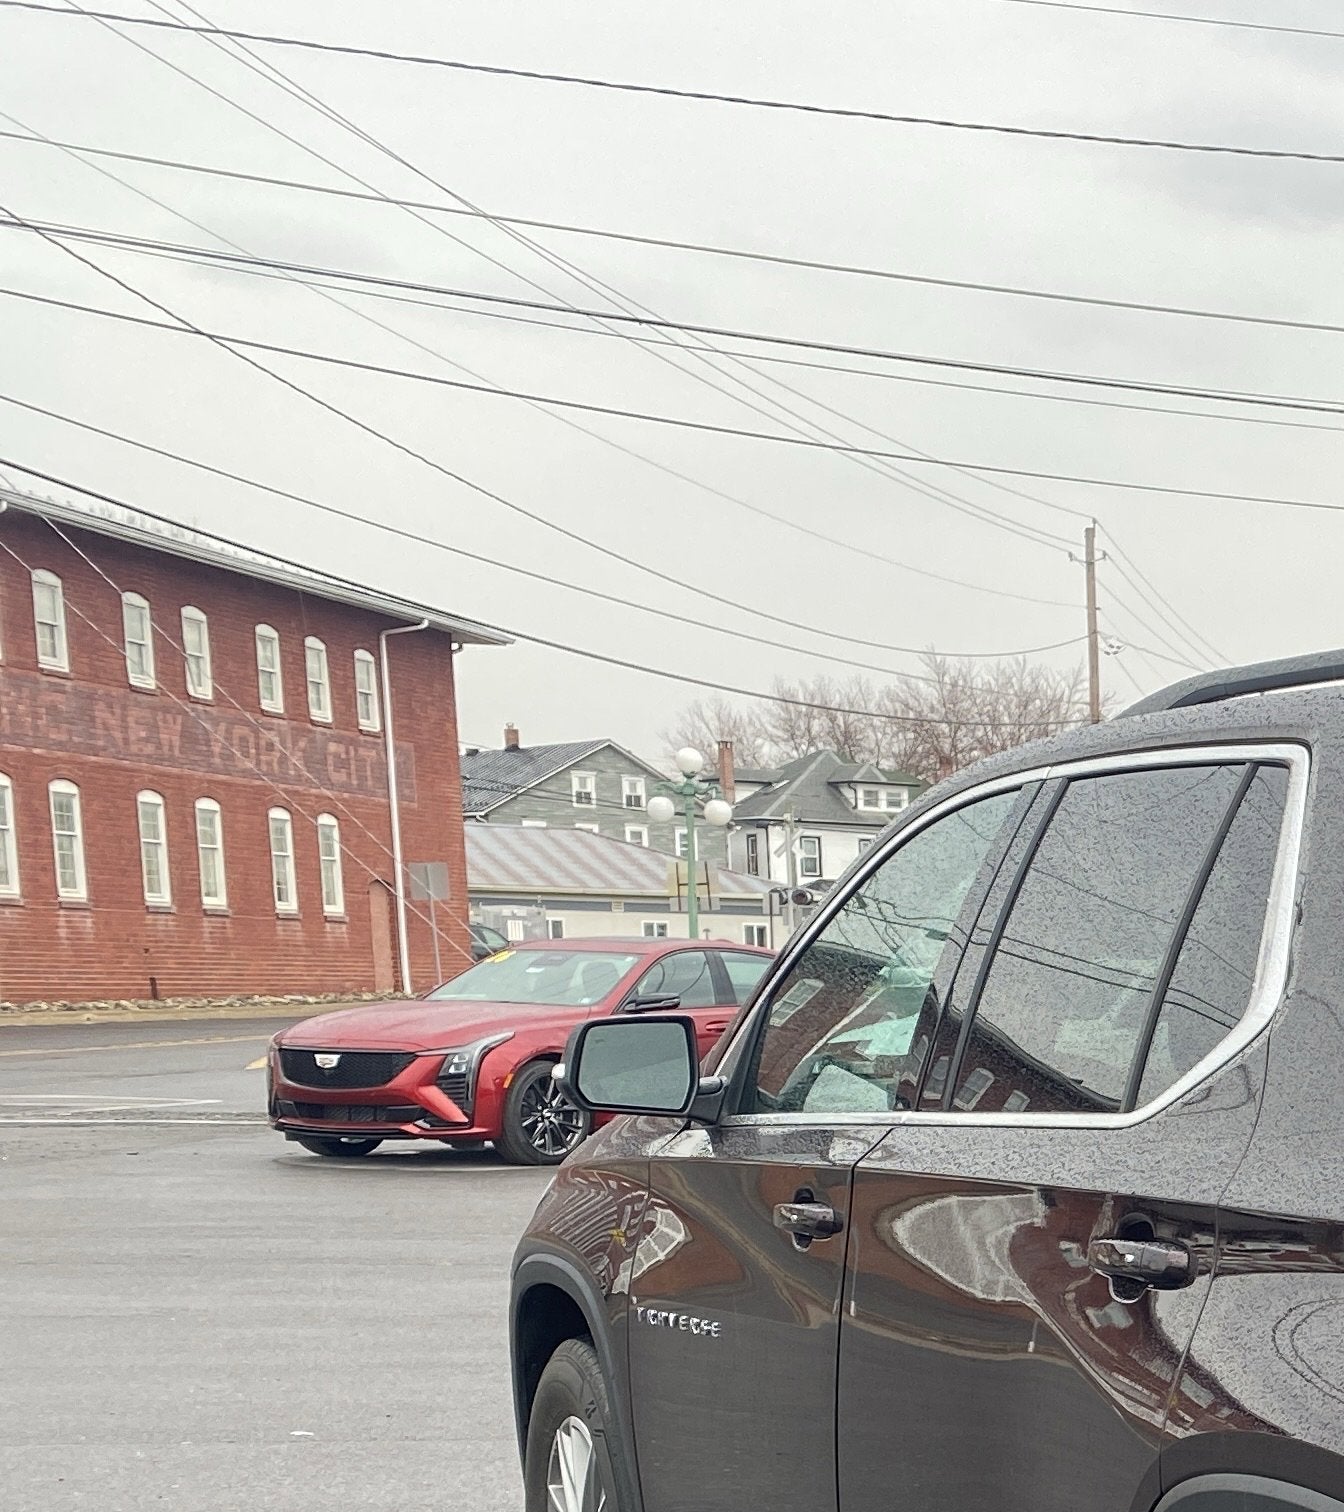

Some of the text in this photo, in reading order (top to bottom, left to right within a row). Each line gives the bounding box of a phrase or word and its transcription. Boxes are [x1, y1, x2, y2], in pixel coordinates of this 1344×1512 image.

[94, 699, 184, 757] NEW
[207, 721, 309, 775] YORK
[326, 741, 398, 788] CIT
